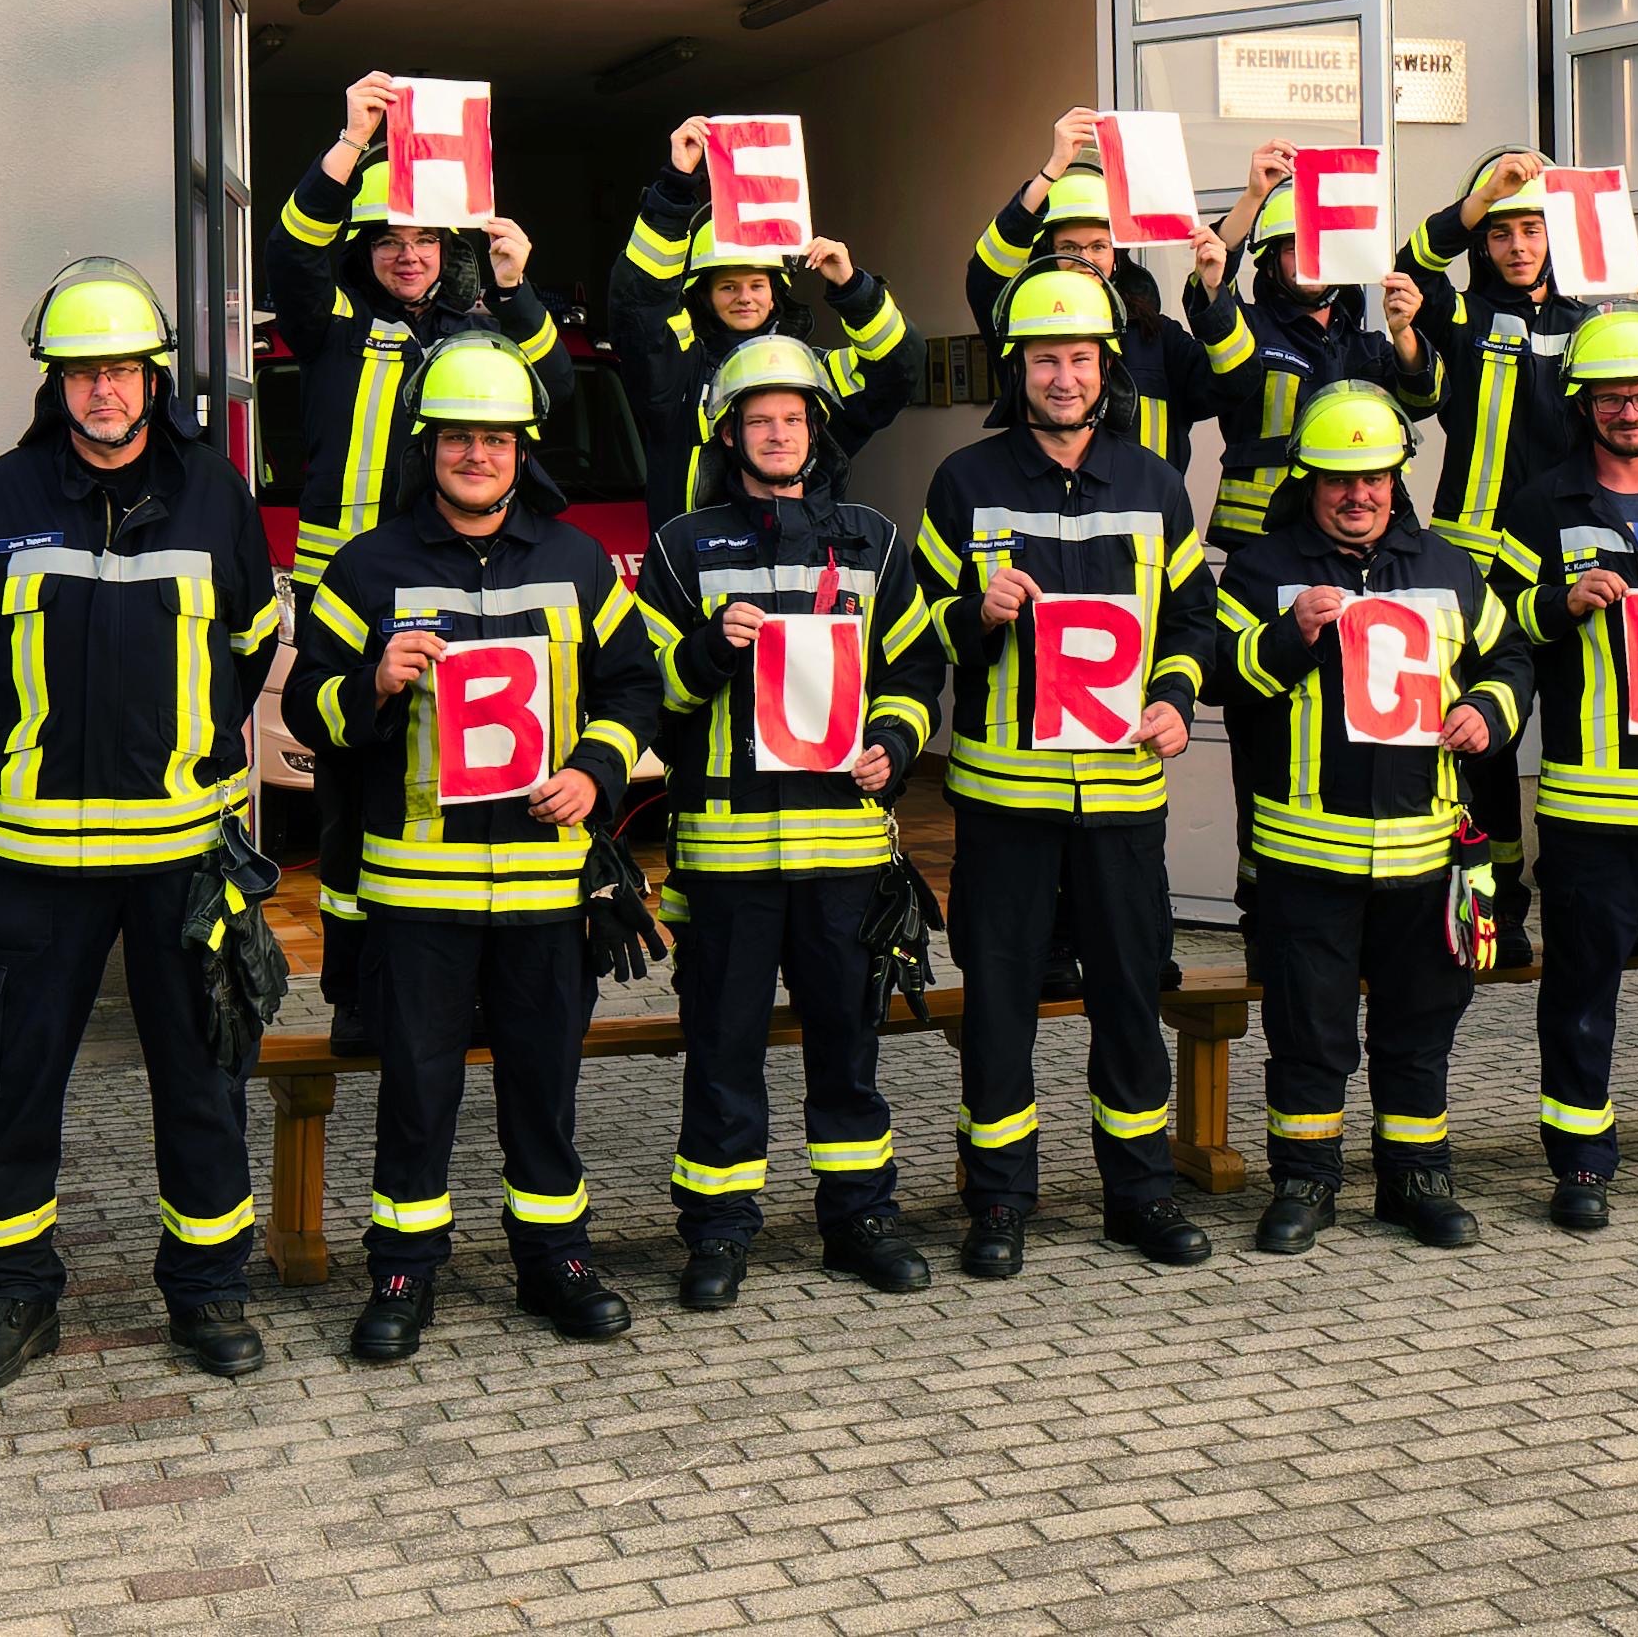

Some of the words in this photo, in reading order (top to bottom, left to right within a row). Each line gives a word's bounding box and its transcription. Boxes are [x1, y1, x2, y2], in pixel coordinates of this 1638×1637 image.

[1235, 48, 1341, 70] FREIWILLIGE
[1348, 51, 1453, 74] FRWEHR
[1288, 82, 1404, 106] PORSCHF
[387, 85, 492, 215] H
[703, 121, 801, 247] E
[1094, 114, 1196, 243] L
[1293, 147, 1380, 281] F
[1544, 168, 1622, 283] T
[1052, 300, 1066, 313] A
[1352, 430, 1364, 443] A
[393, 620, 415, 629] Lukas
[434, 647, 544, 798] B
[756, 620, 862, 772] U
[1034, 599, 1142, 744] R
[1338, 598, 1444, 740] G
